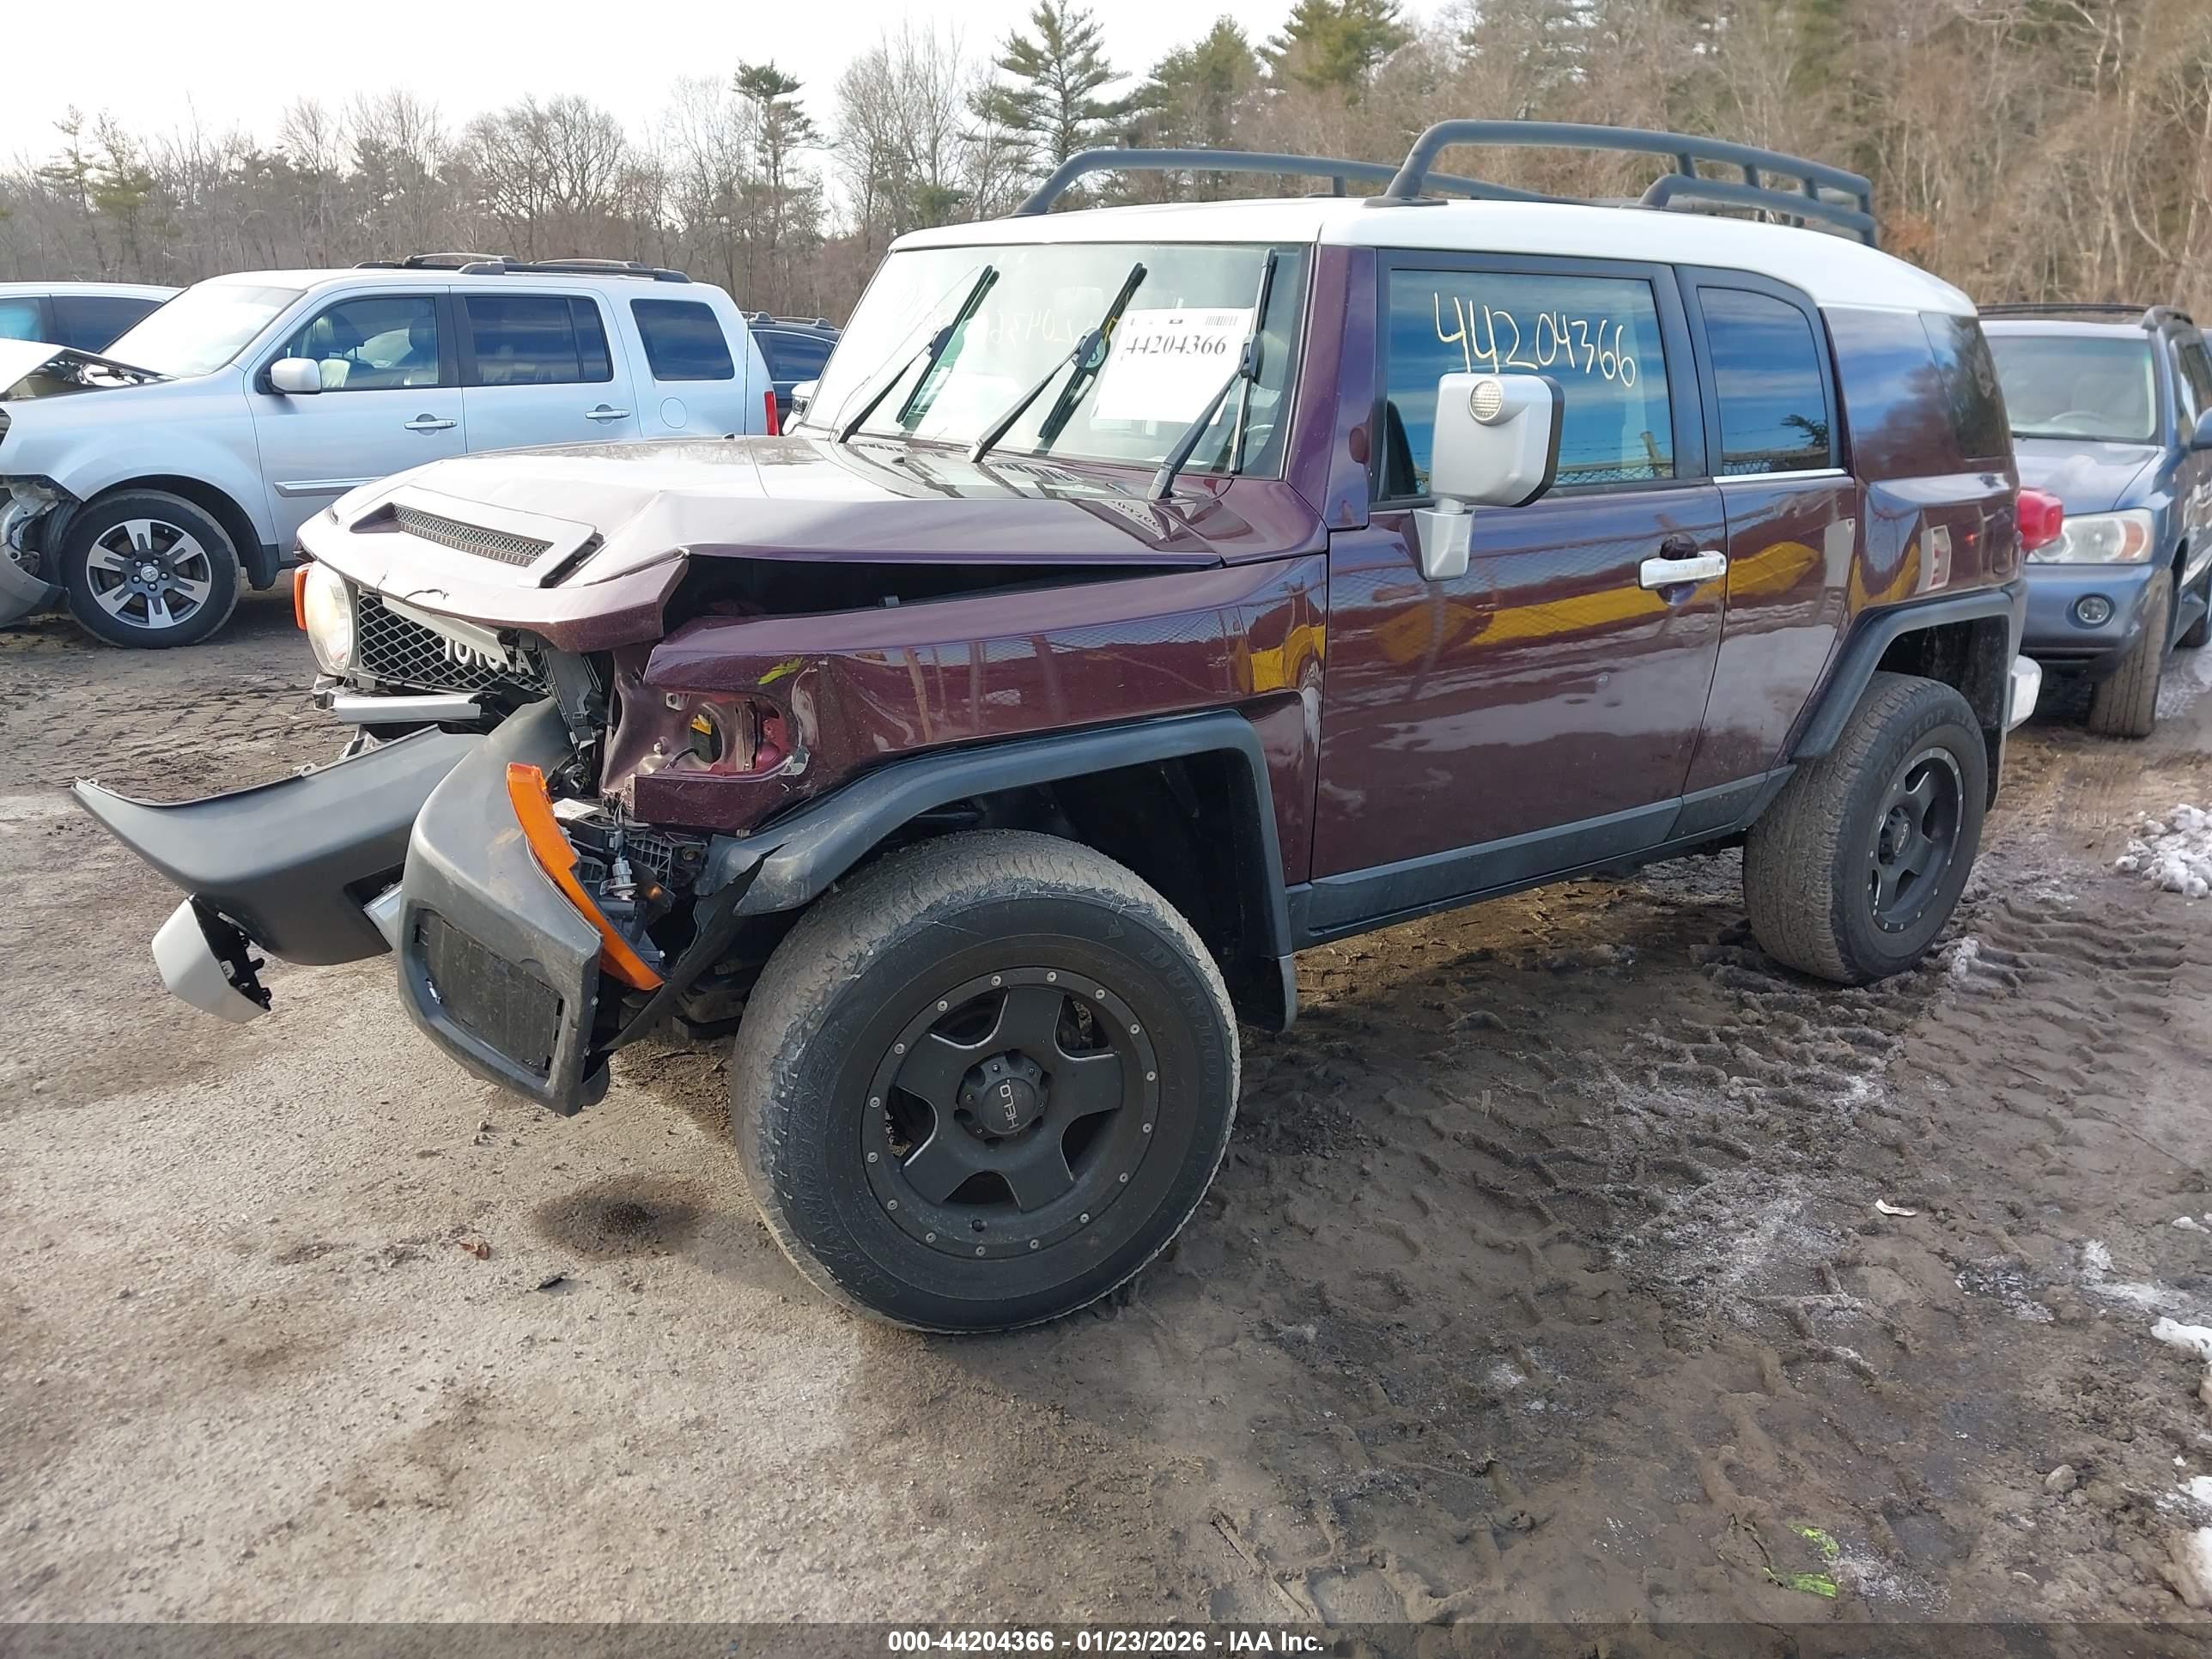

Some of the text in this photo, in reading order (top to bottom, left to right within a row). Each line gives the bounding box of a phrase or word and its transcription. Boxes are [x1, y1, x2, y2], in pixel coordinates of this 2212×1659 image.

[1126, 334, 1230, 356] 44204366
[1434, 291, 1636, 387] 44204366
[1000, 1084, 1019, 1129] HELO
